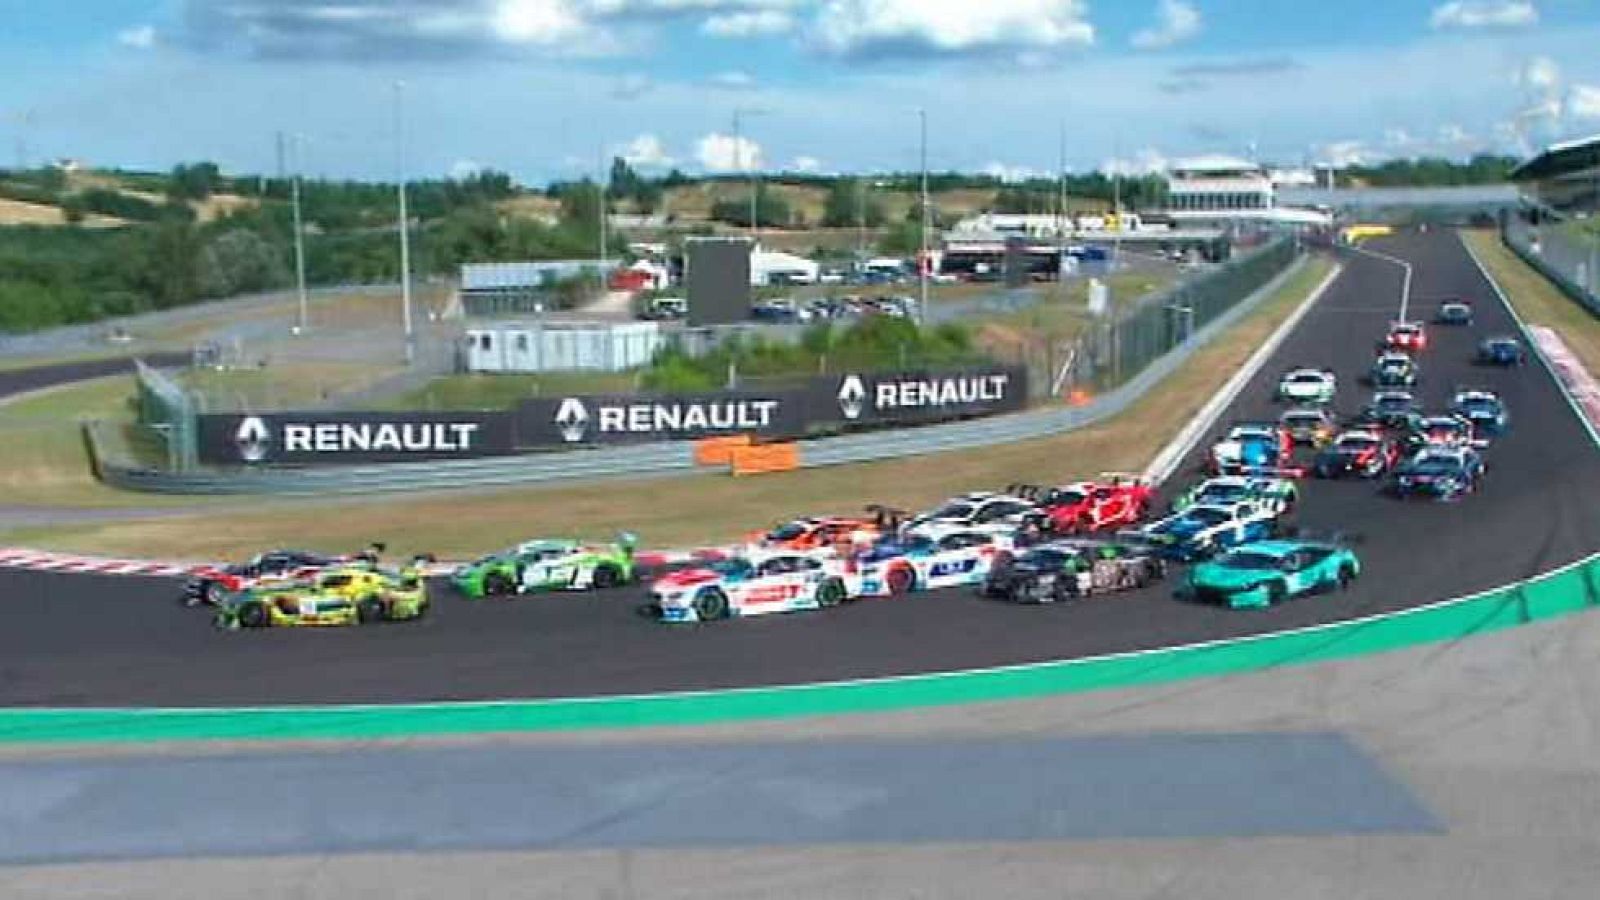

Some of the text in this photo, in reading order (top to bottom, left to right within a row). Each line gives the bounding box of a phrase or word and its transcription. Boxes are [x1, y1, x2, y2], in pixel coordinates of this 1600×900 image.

[876, 374, 1009, 410] RENAULT
[598, 400, 779, 433] RENAULT
[284, 422, 479, 451] RENAULT
